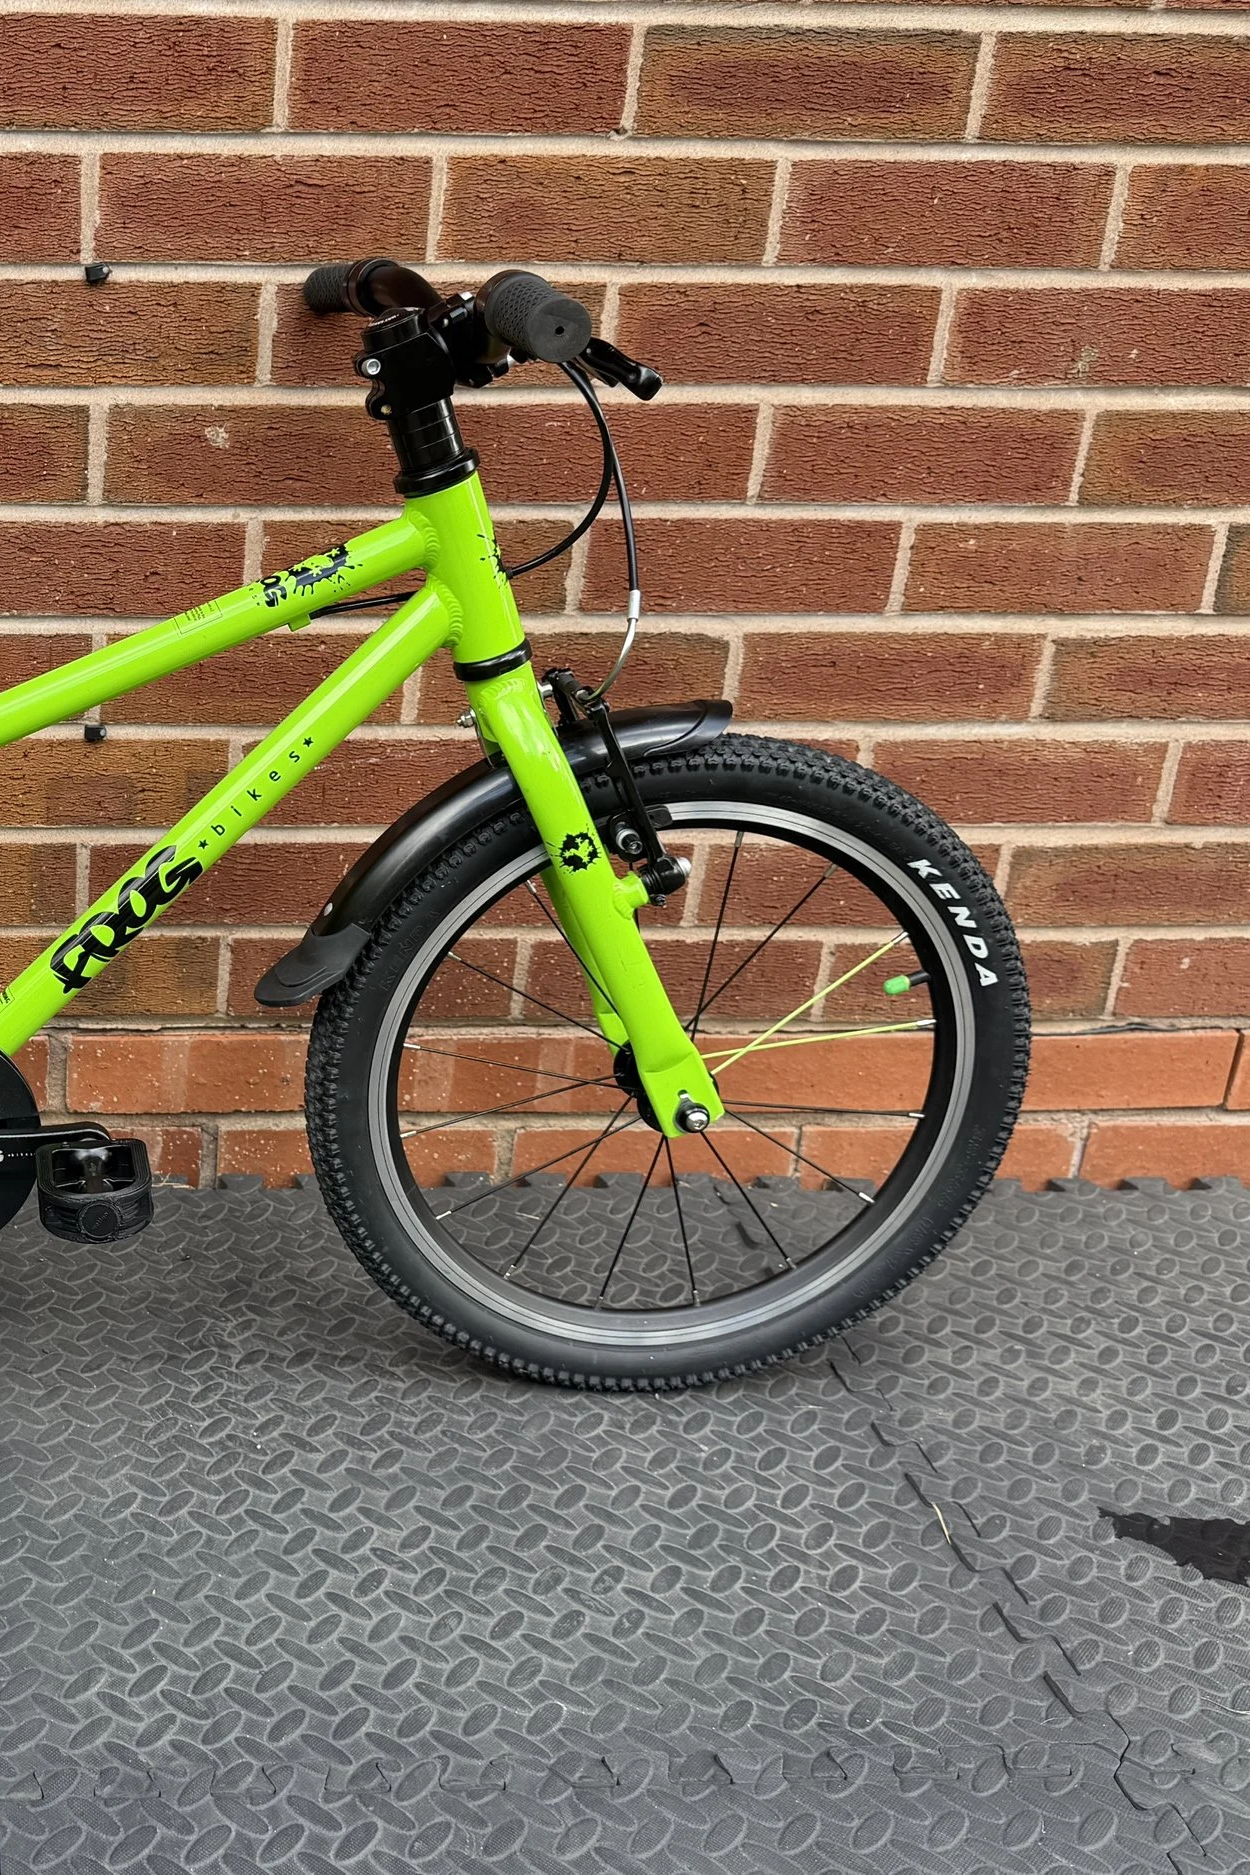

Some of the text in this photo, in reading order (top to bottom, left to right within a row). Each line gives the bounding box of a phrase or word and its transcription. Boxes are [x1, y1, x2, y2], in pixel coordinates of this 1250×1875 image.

[50, 750, 301, 994] FROG bikes
[907, 858, 999, 987] KENDA
